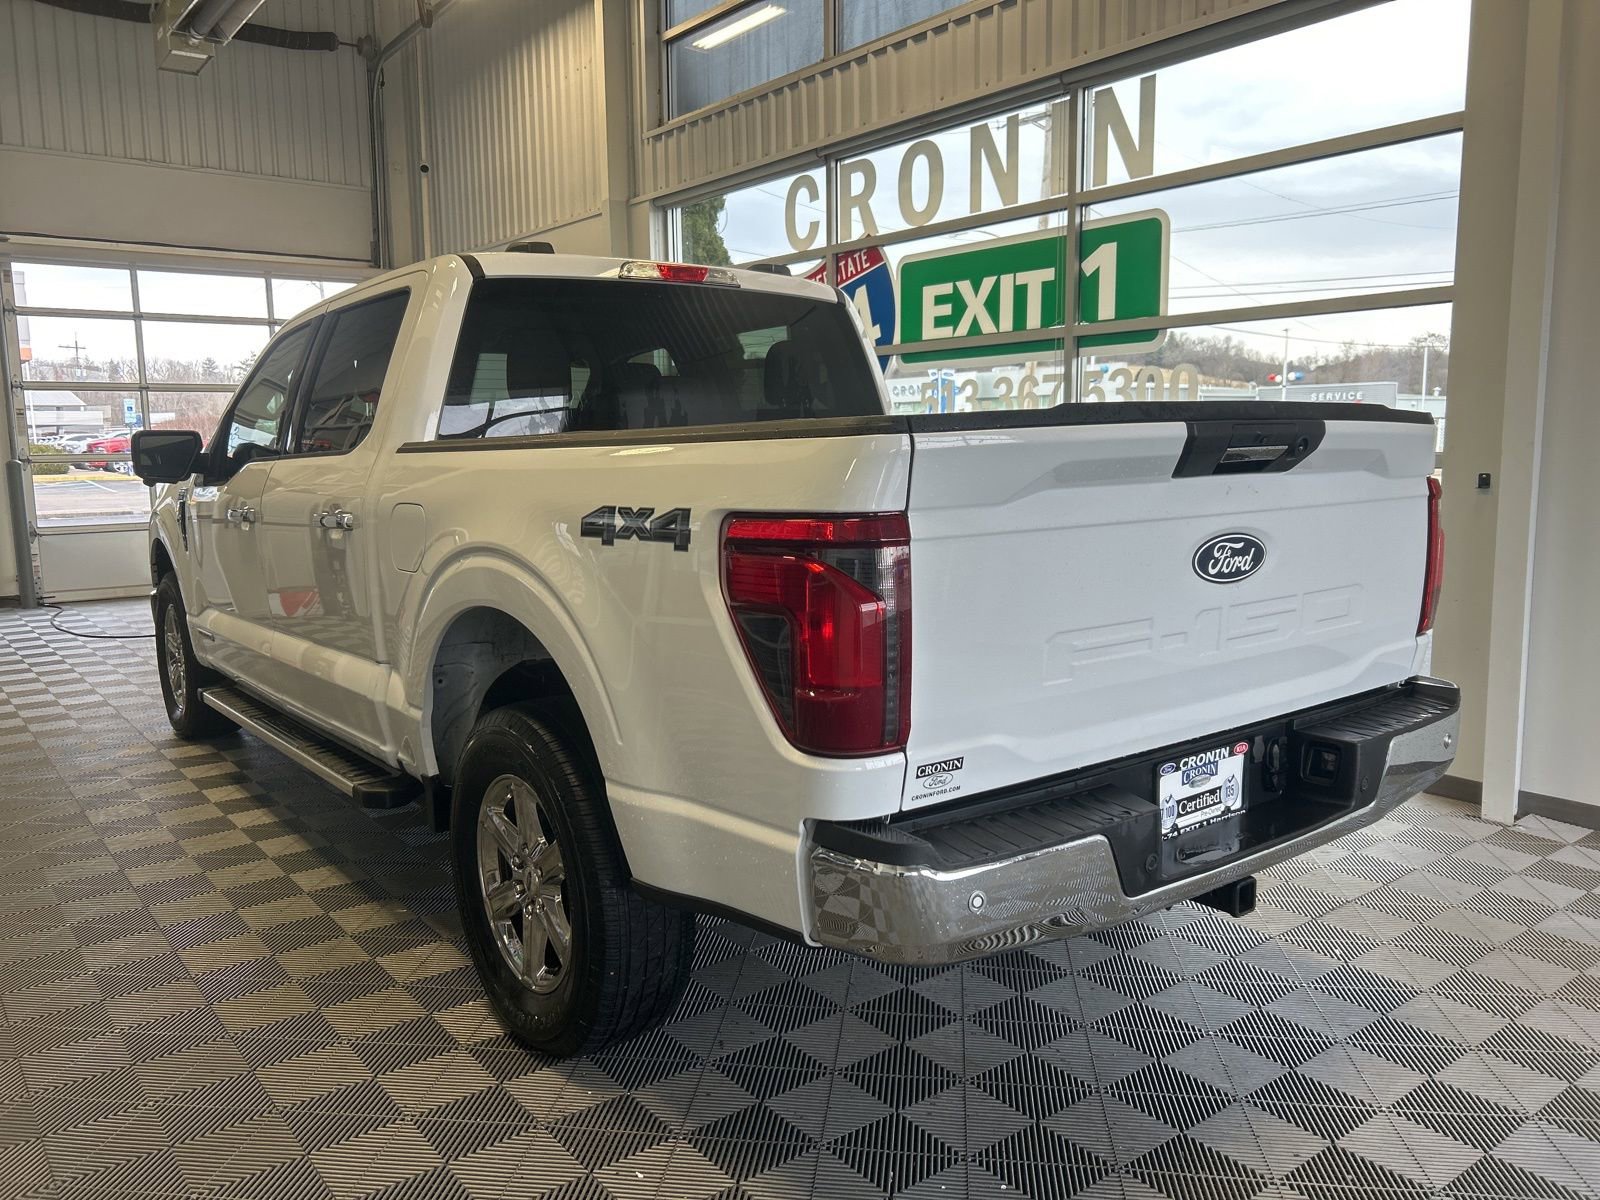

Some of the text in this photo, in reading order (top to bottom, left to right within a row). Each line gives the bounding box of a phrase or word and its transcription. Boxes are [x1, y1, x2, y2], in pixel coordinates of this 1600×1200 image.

[785, 74, 1156, 252] CRONIN
[922, 241, 1118, 341] EXIT 1
[1311, 391, 1363, 401] SERVICE
[1043, 583, 1364, 686] F-150
[918, 758, 963, 777] CRONIN
[1180, 747, 1229, 770] CRONIN
[1184, 763, 1217, 784] CRONIN
[911, 785, 961, 801] CRONINFORD.COM
[1179, 790, 1220, 814] Certified
